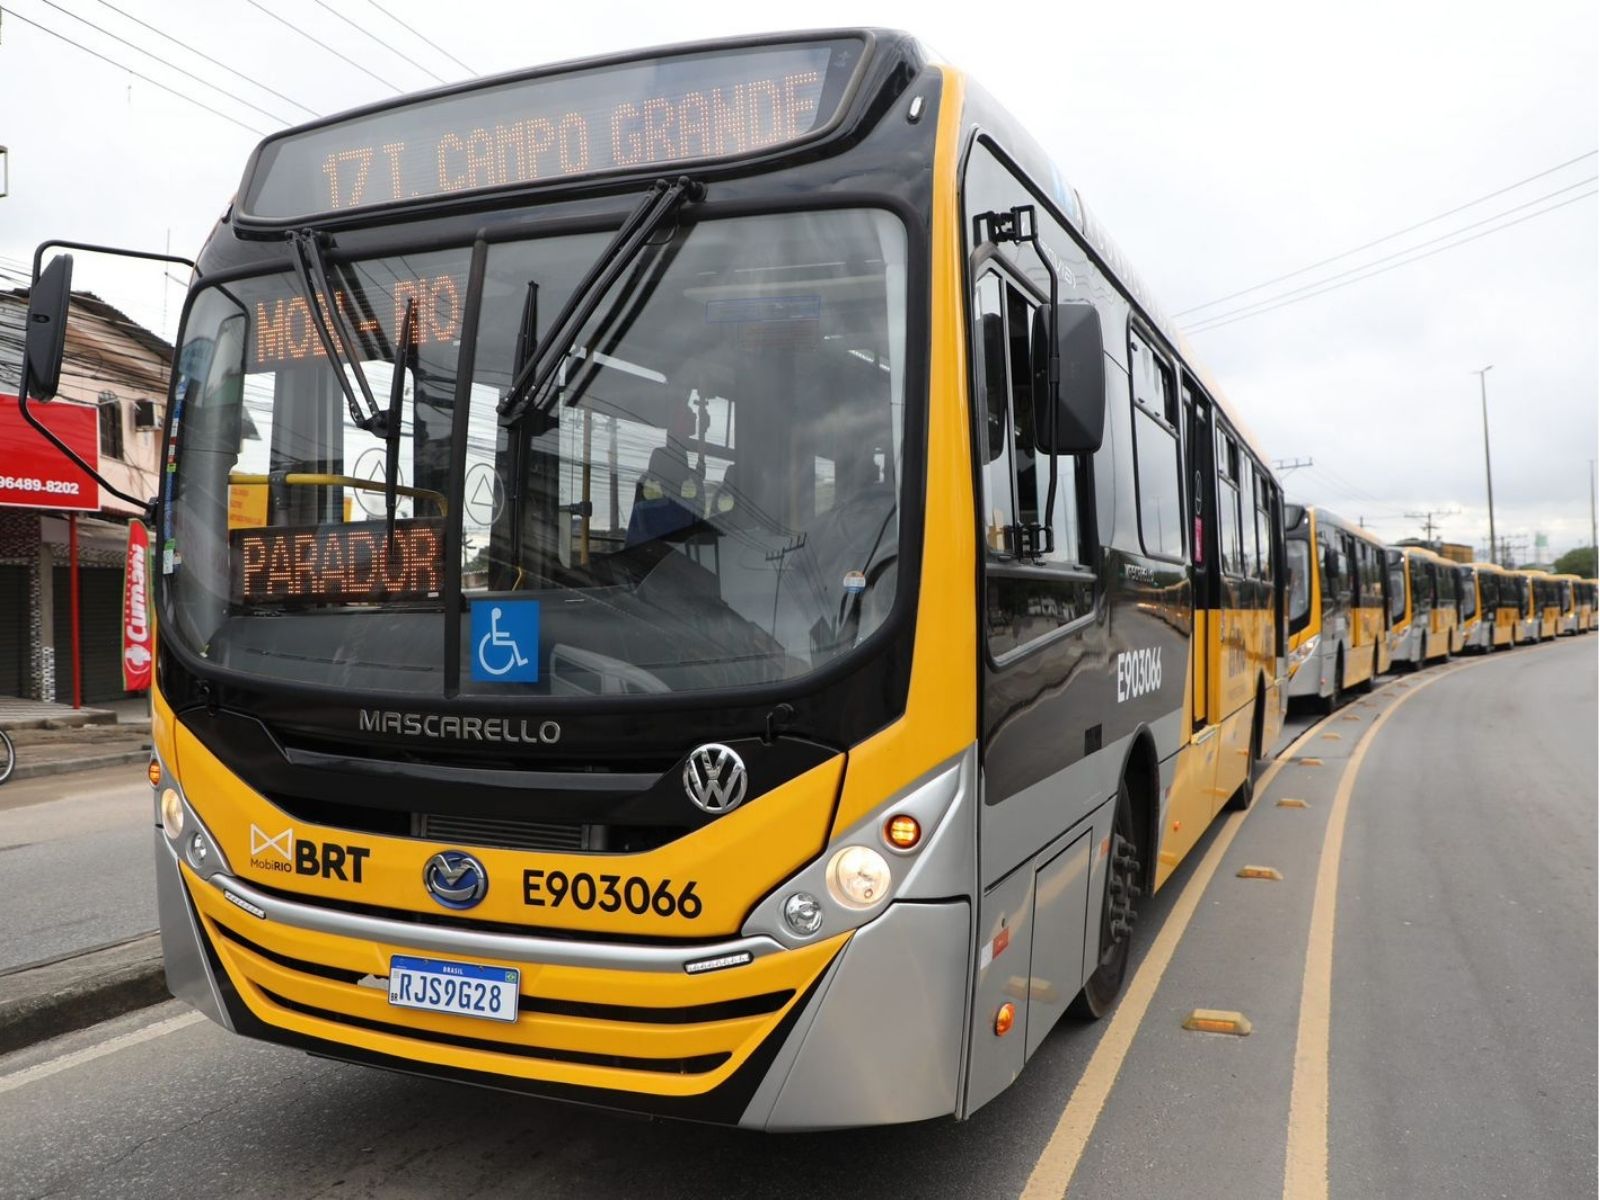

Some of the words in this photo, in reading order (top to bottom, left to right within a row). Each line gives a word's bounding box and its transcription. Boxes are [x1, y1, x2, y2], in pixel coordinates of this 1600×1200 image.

[322, 147, 373, 209] 17
[437, 111, 589, 192] CAMPO
[611, 71, 818, 167] GRANDE
[394, 275, 460, 347] RIO
[243, 528, 437, 596] PARADOR
[1117, 646, 1162, 704] E903066
[359, 708, 561, 744] MASCARELLO
[250, 857, 292, 873] MobiRIO
[295, 838, 371, 884] BRT
[522, 868, 703, 920] E903066
[400, 973, 501, 1014] RJS9G28
[442, 965, 464, 975] BRASIL
